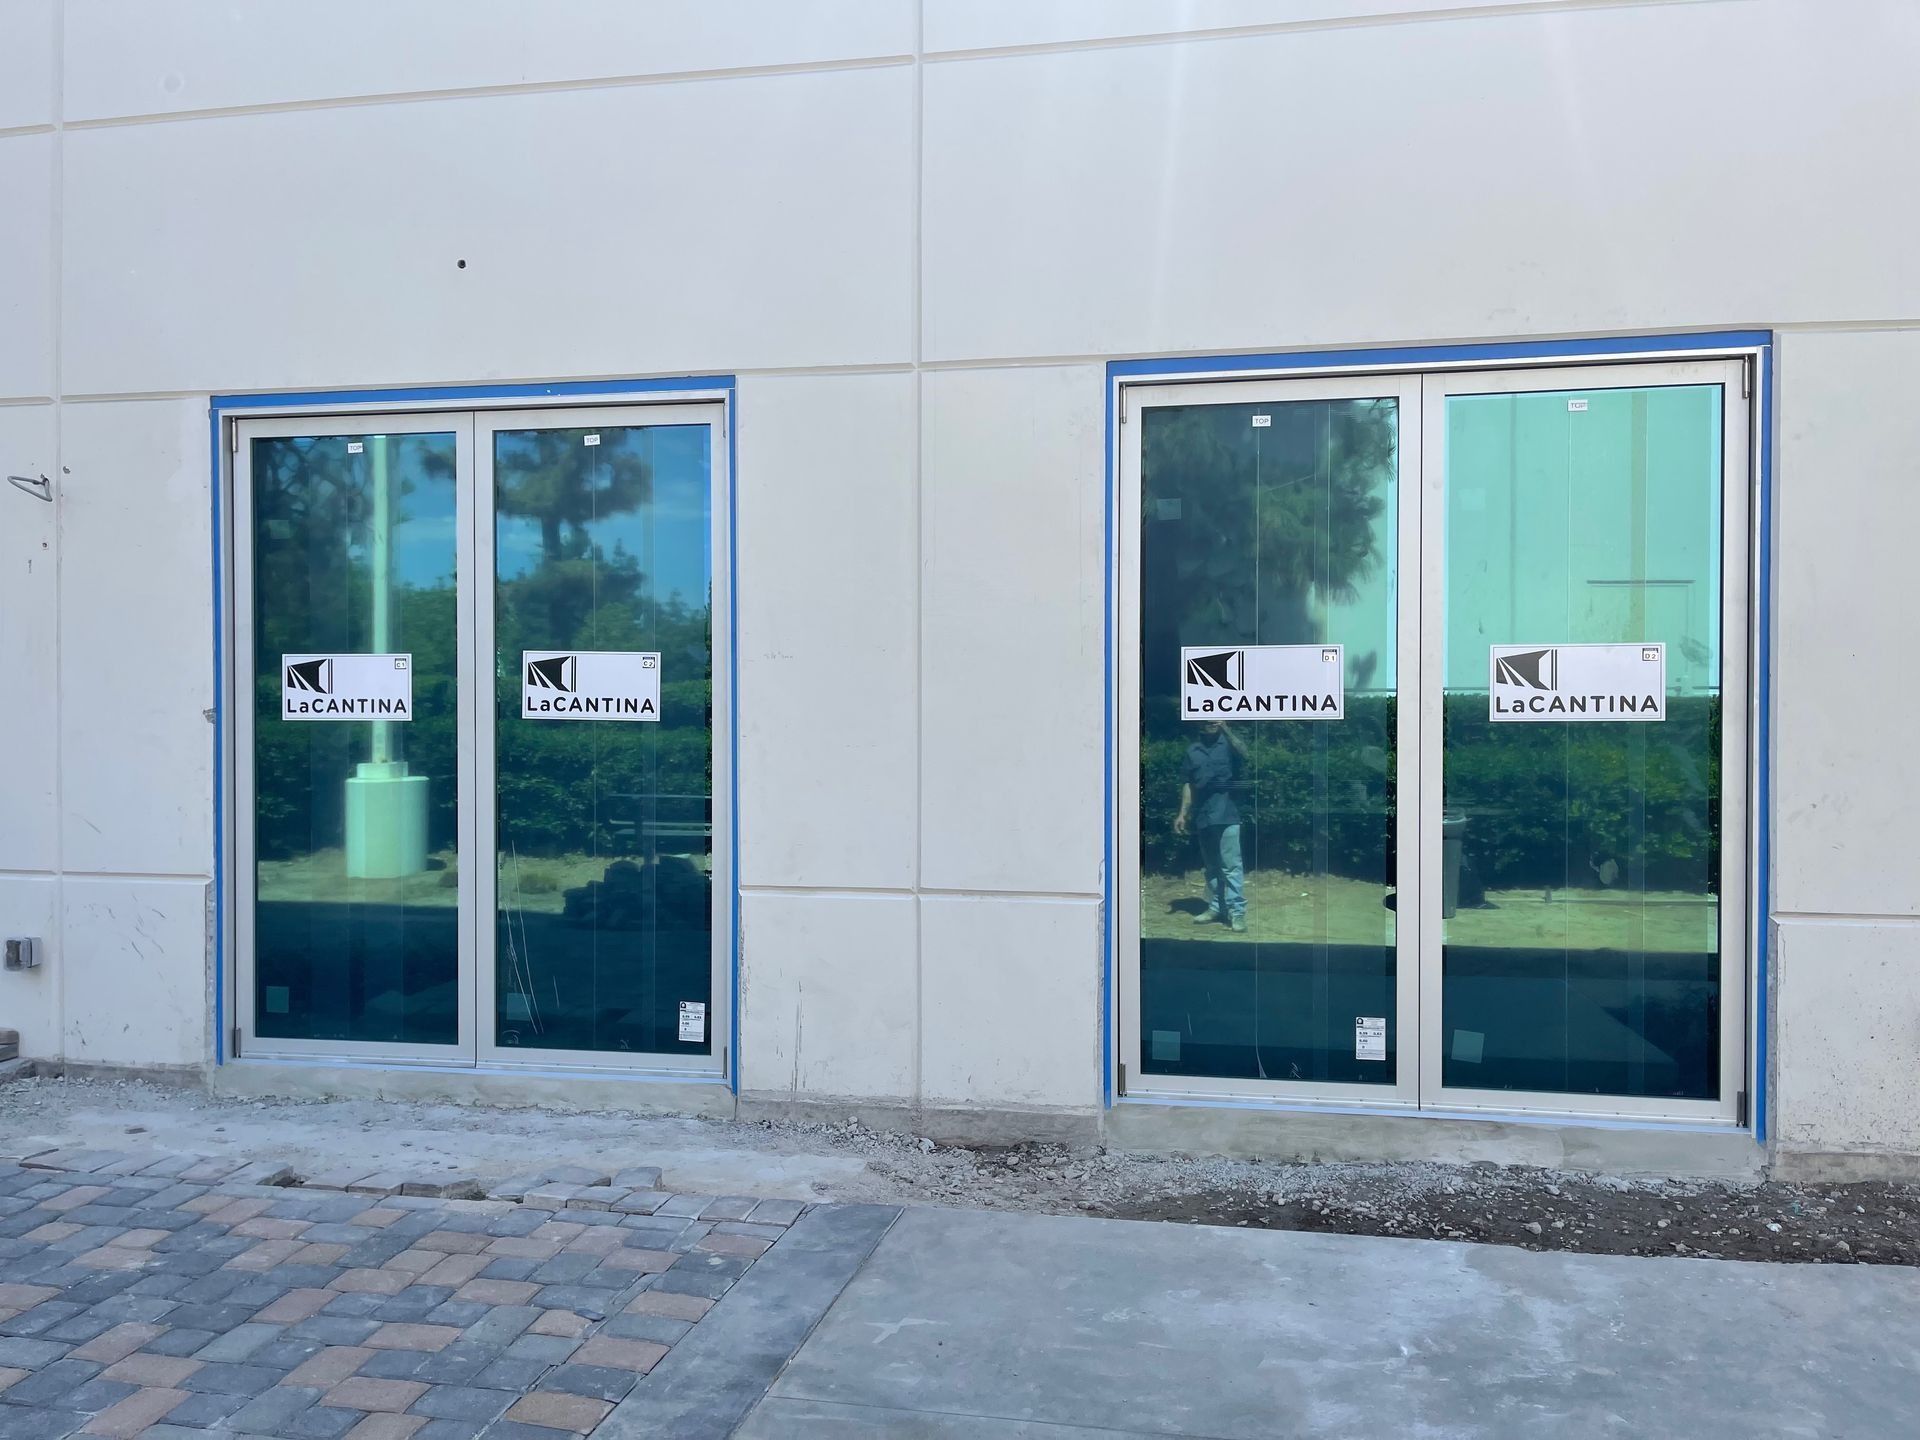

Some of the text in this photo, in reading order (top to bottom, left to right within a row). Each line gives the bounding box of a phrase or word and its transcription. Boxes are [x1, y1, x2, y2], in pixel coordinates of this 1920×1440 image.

[287, 698, 407, 714] LaCANTINA
[527, 696, 655, 714] LaCANTINA
[1187, 694, 1337, 712] LaCANTINA
[1496, 695, 1658, 713] LaCANTINA
